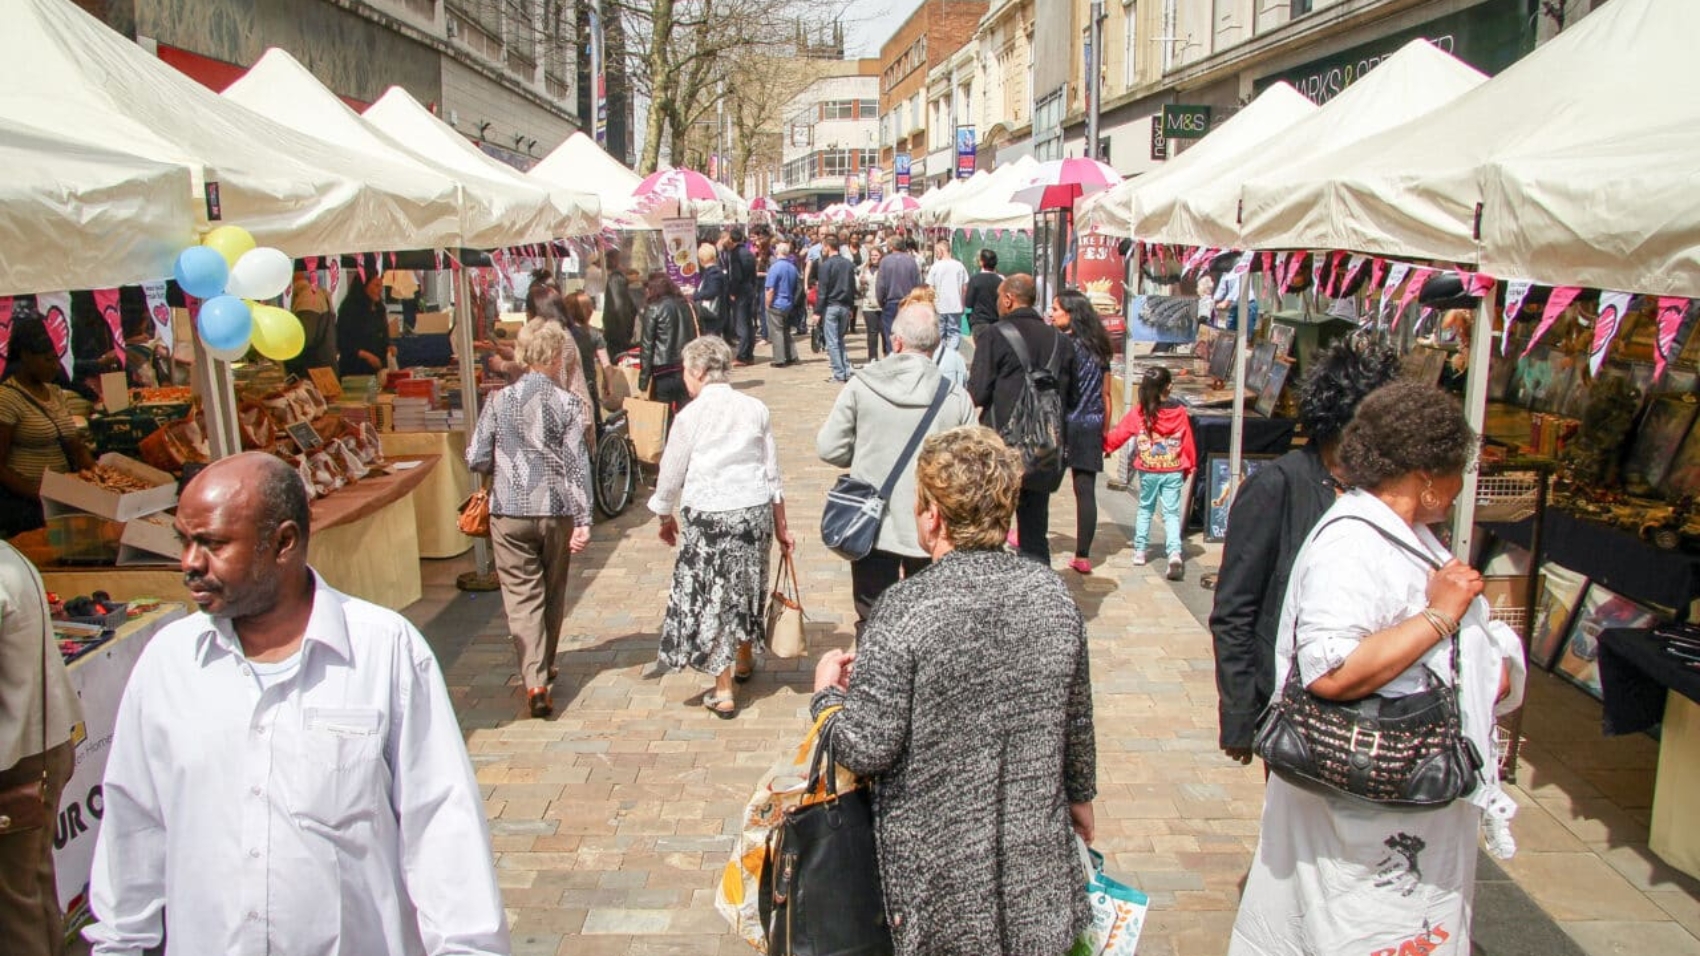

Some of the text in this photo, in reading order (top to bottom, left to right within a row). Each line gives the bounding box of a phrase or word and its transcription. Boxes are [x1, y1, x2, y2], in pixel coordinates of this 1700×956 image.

[1295, 69, 1341, 107] ARKS
[1167, 113, 1205, 131] M&S
[54, 801, 89, 850] UR
